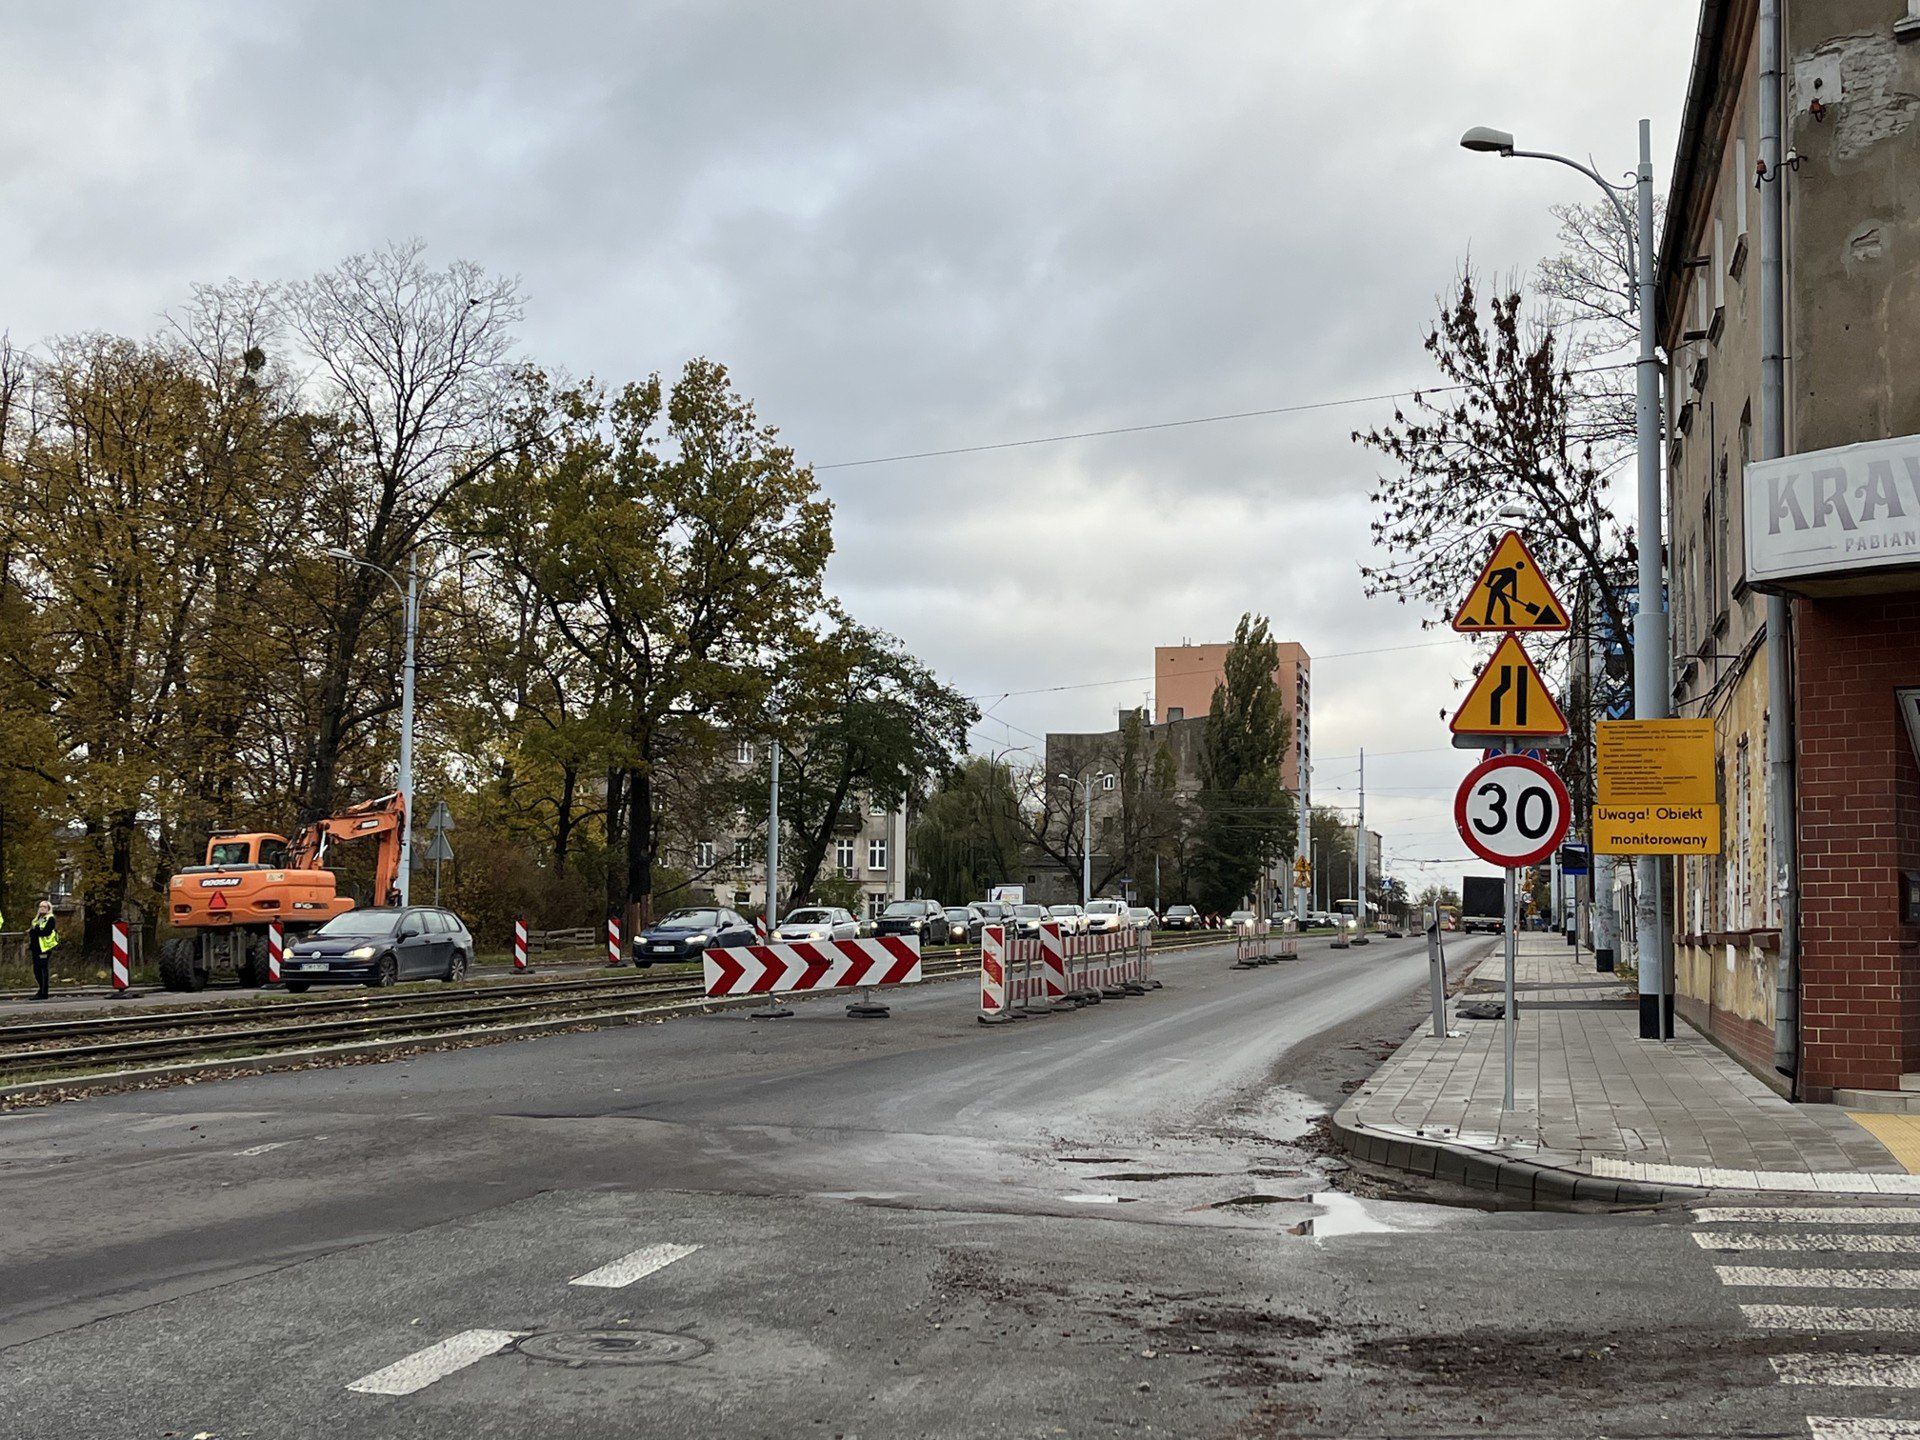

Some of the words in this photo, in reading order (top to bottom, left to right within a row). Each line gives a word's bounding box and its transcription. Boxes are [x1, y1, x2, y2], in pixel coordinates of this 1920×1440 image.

[1845, 531, 1920, 552] PABIAN
[1473, 783, 1552, 839] 30
[1598, 808, 1650, 823] Uwaga!
[1656, 808, 1703, 819] Obiekt
[1611, 833, 1708, 848] monitorowany
[202, 879, 240, 887] DOOSAN
